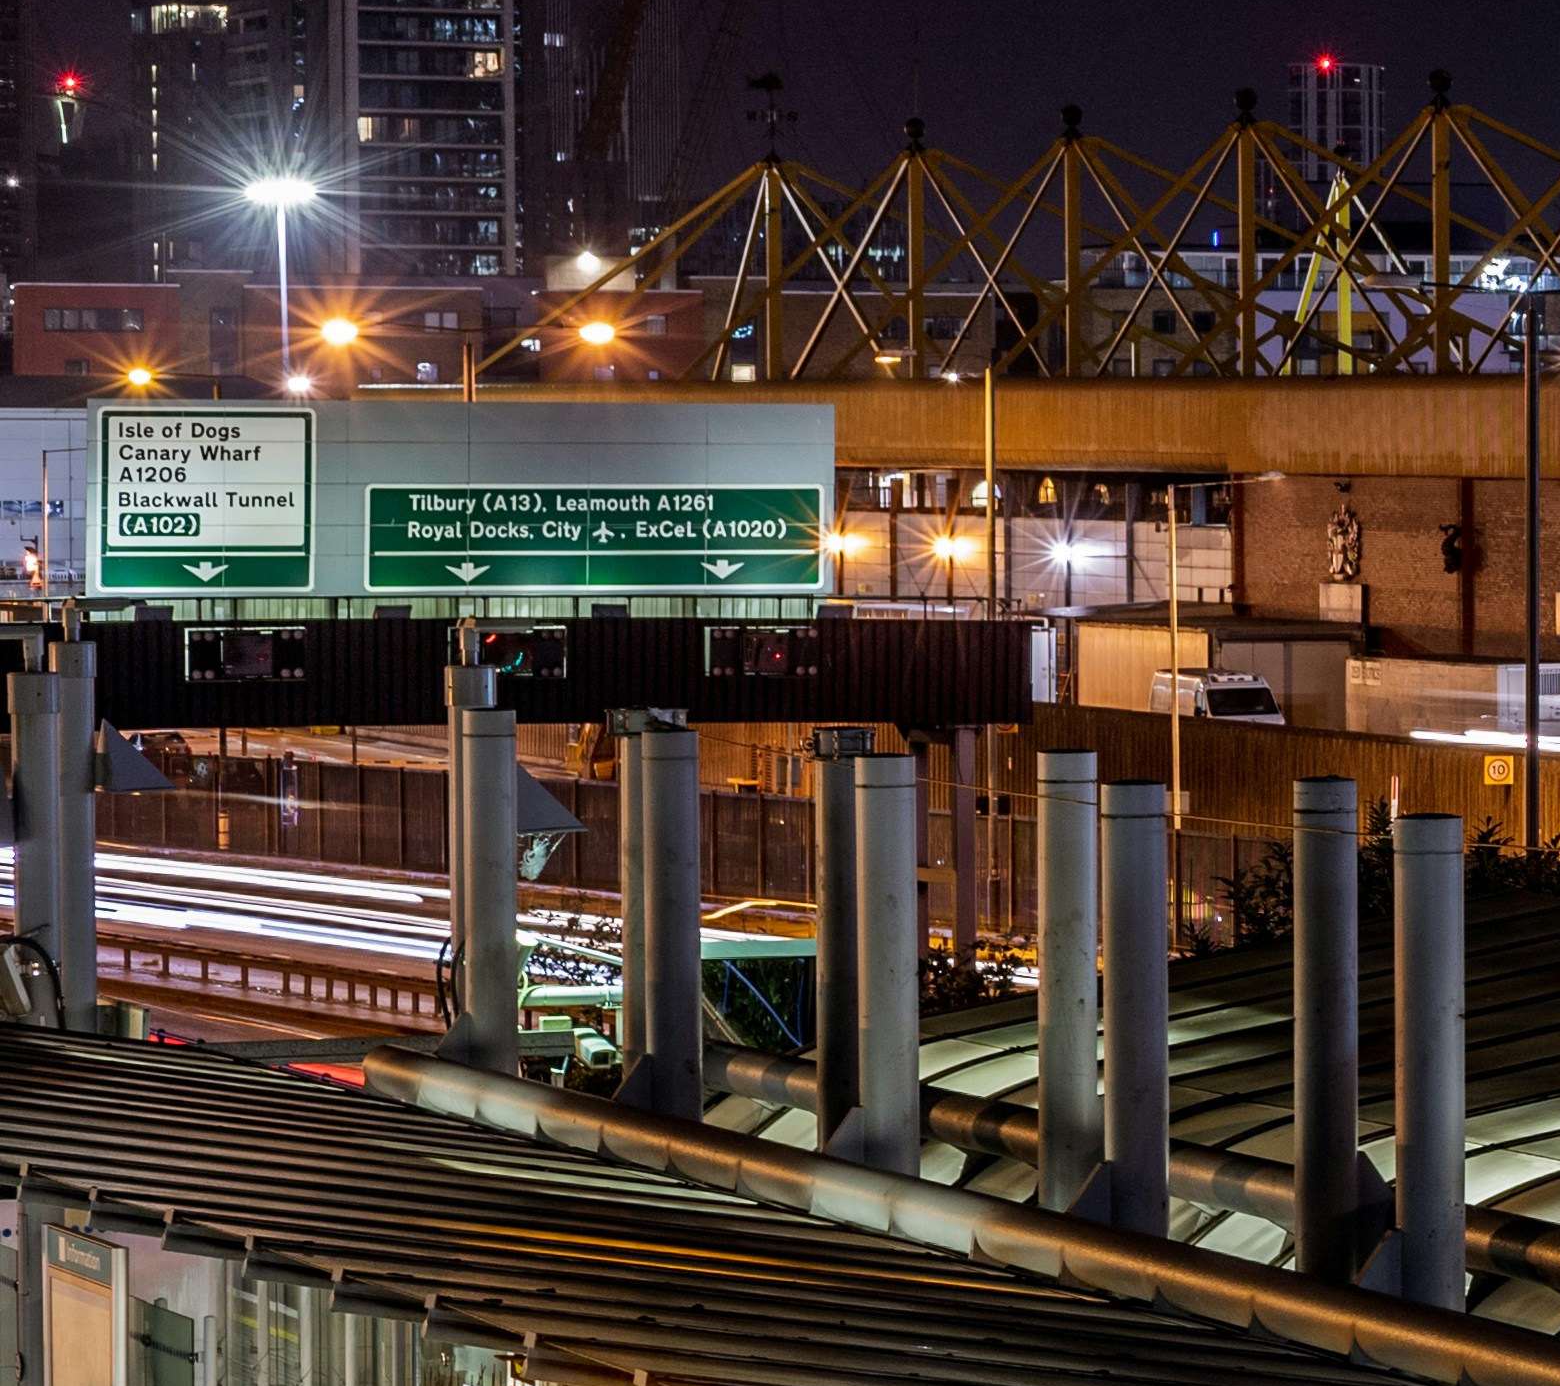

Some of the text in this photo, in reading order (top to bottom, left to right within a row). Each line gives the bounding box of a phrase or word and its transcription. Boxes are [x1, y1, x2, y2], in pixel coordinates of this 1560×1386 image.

[119, 422, 241, 442] Isle of Dogs
[119, 444, 262, 463] Canary Wharf
[119, 466, 187, 483] A1206
[119, 491, 295, 508] Blackwall Tunnel
[409, 492, 714, 514] Tilbury (A13), Leamouth A1261
[122, 514, 197, 535] (A102)
[408, 518, 787, 542] Royal Docks, City ExCeL (A1020)
[1492, 765, 1505, 775] 10
